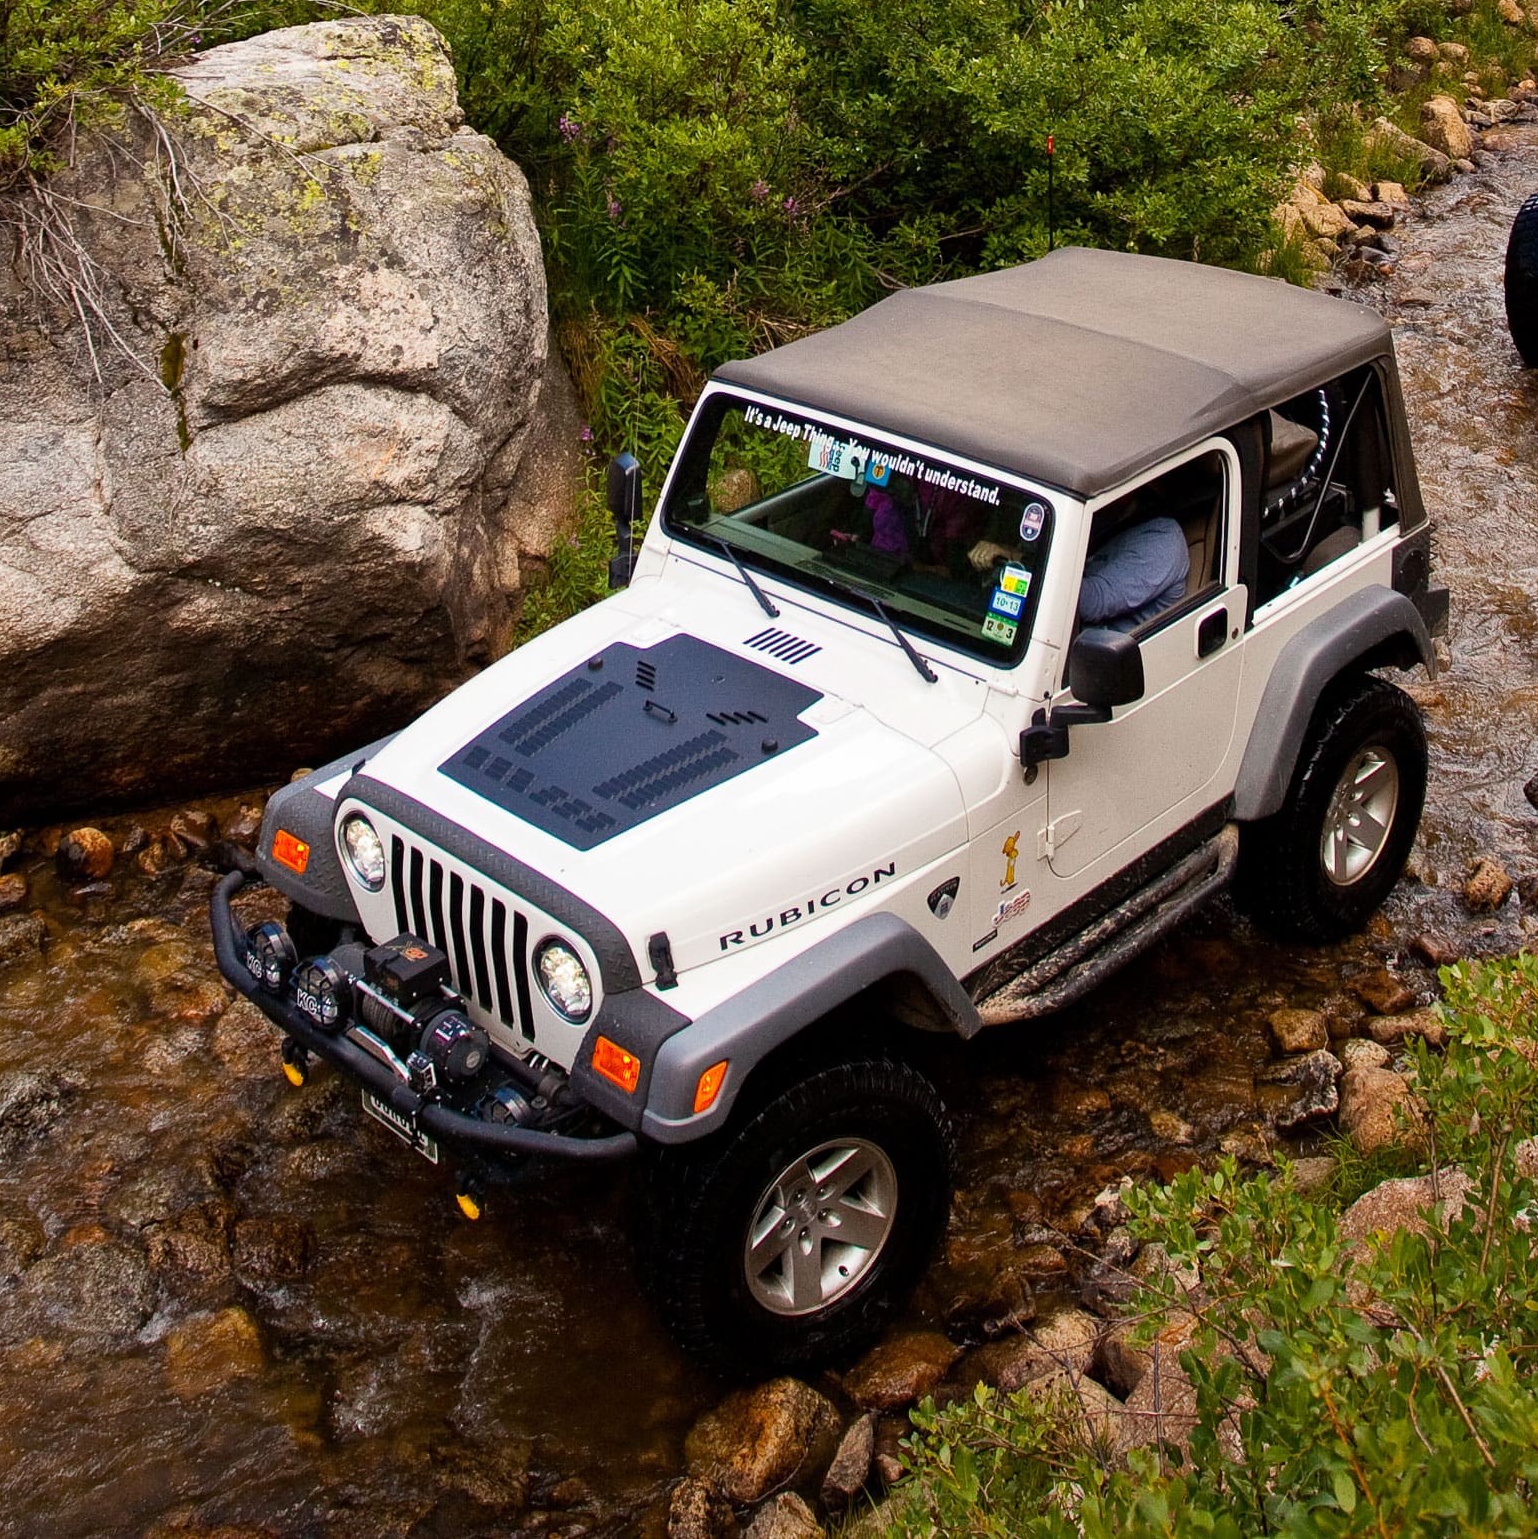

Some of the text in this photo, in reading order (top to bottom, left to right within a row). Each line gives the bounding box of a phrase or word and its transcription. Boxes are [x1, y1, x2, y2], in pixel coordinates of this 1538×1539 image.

[744, 405, 764, 427] It's
[763, 415, 773, 429] a
[772, 415, 801, 441] Jeep
[849, 437, 871, 461] You
[871, 449, 925, 479] wouldn't
[924, 468, 1002, 506] understand.
[719, 862, 896, 951] RUBICON
[297, 988, 318, 1015] KC
